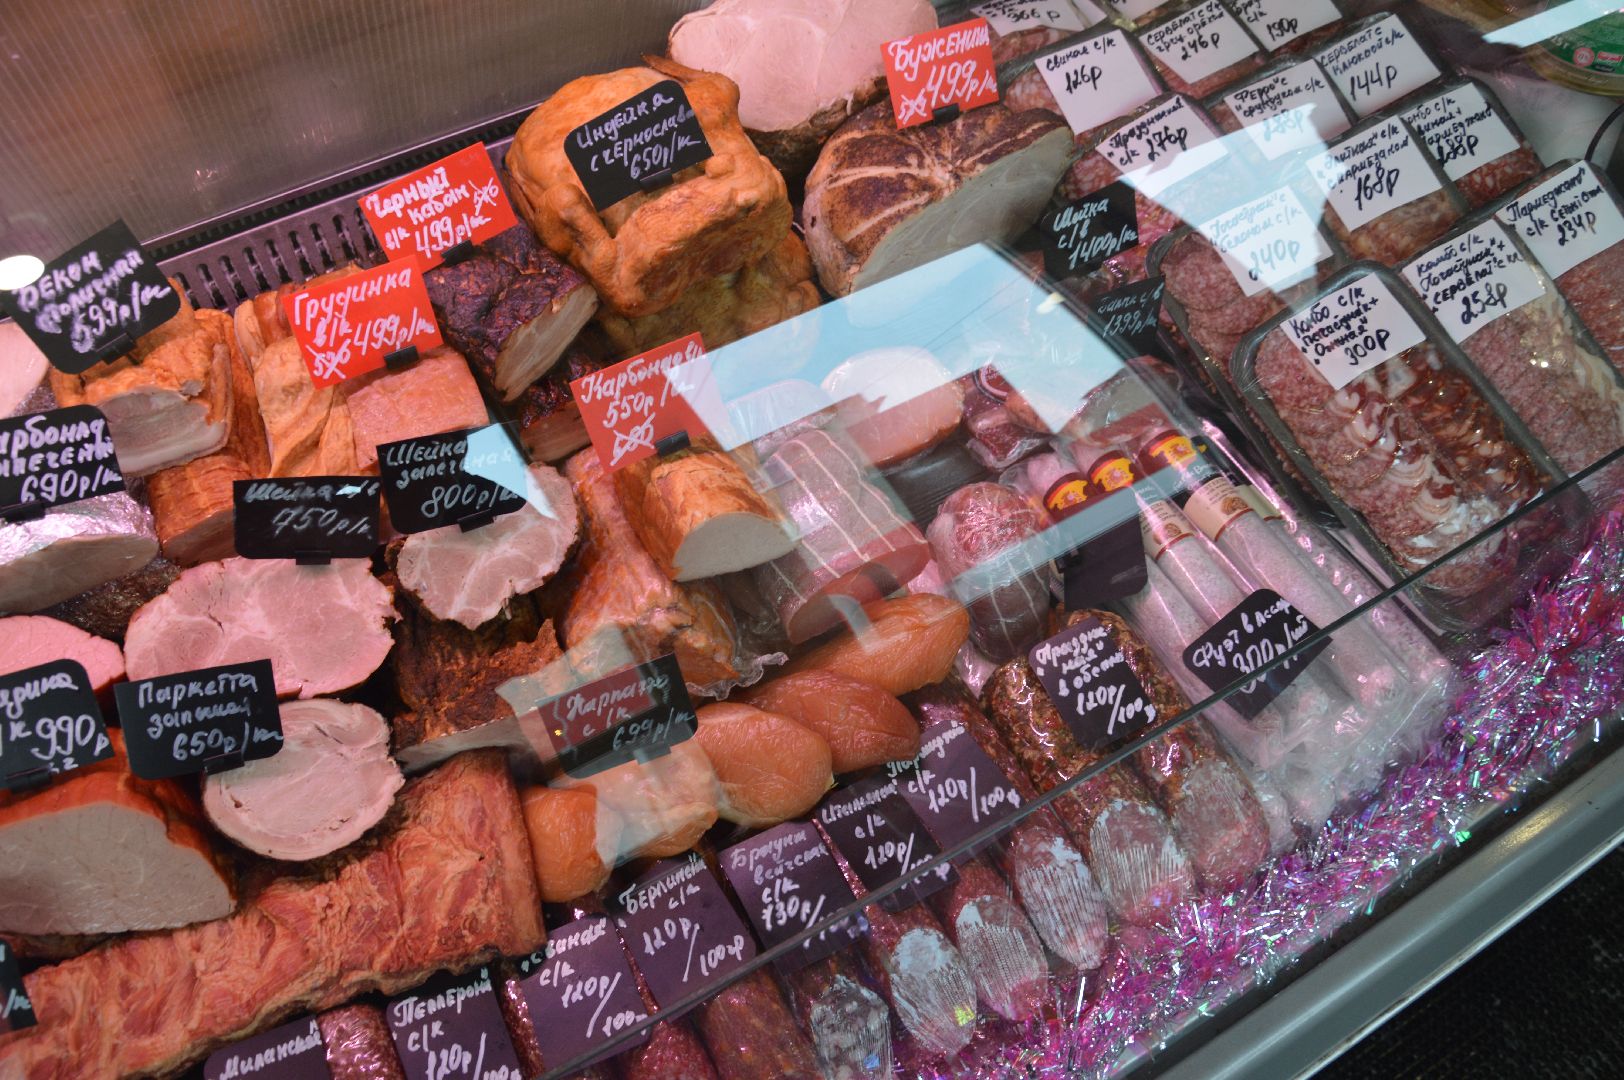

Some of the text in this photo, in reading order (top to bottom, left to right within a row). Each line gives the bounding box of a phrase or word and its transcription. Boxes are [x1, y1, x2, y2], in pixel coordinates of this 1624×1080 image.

[1066, 64, 1102, 95] 126р
[1350, 62, 1398, 101] 144р
[1354, 162, 1400, 211] 168р
[294, 267, 413, 332] Грудинка
[1344, 328, 1391, 366] 300р
